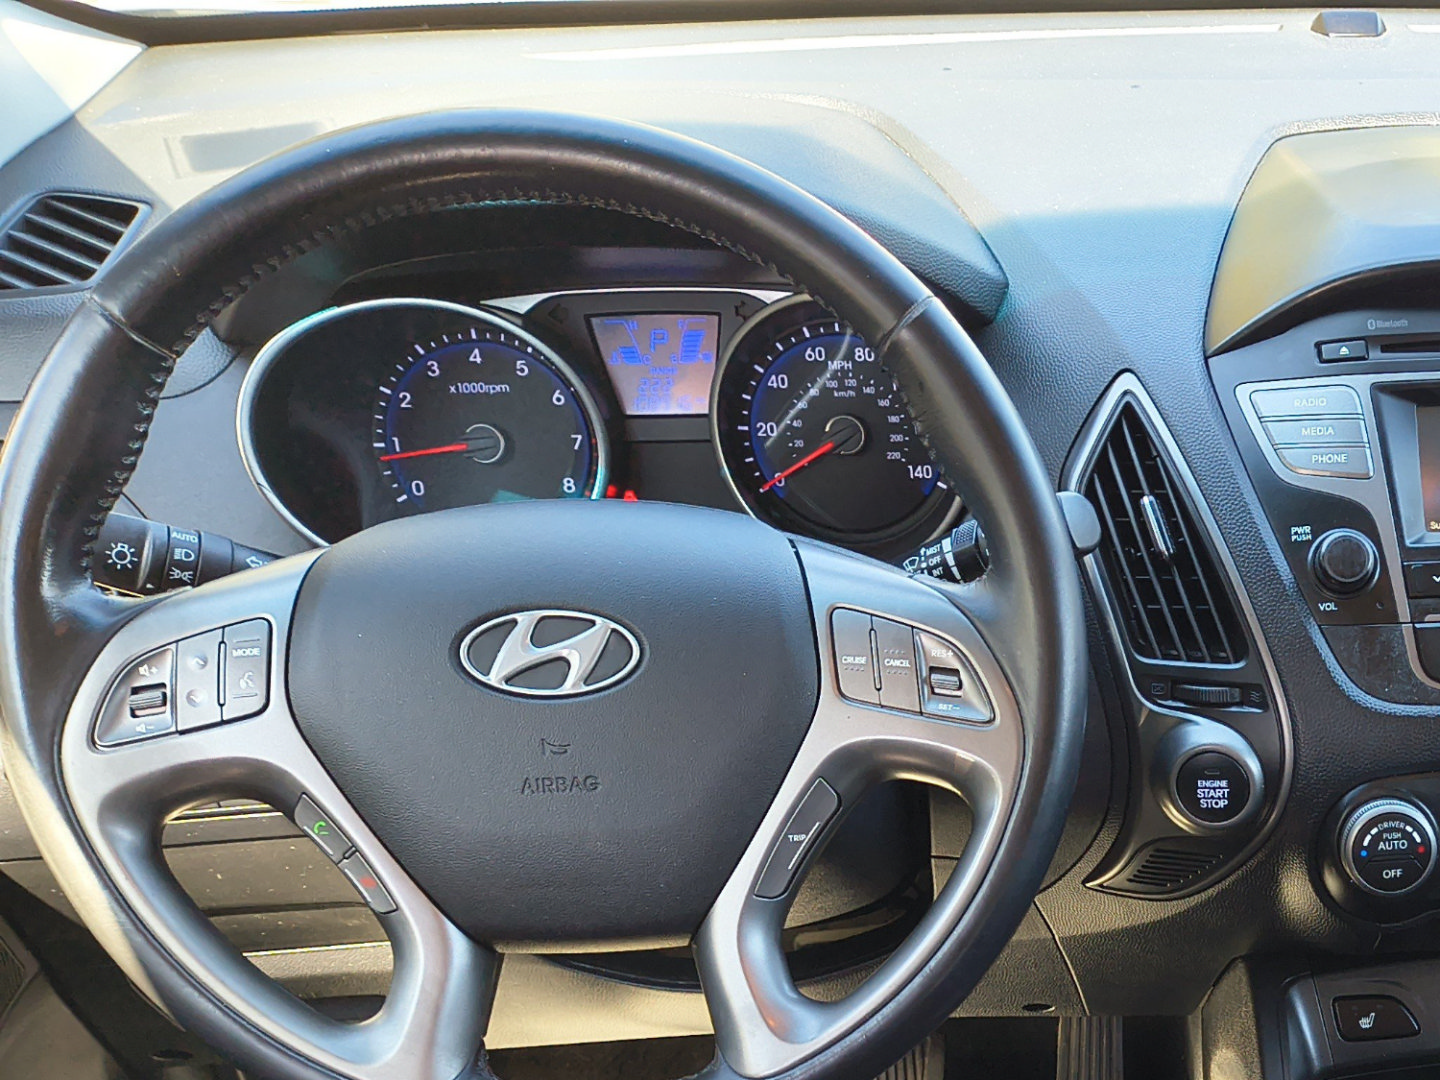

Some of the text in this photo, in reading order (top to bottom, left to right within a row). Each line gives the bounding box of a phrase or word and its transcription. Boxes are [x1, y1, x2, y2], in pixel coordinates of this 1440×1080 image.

[650, 328, 669, 353] P
[469, 348, 482, 364] 4
[805, 347, 825, 361] 60
[855, 347, 875, 361] 80
[427, 361, 440, 377] 3
[515, 361, 529, 377] 5
[827, 361, 852, 371] MPH
[767, 374, 788, 389] 40
[825, 380, 838, 389] 100
[844, 378, 857, 387] 120
[449, 382, 510, 395] x1000rpm
[833, 389, 856, 398] km/h
[862, 386, 875, 394] 140
[399, 392, 413, 408] 2
[552, 390, 565, 406] 6
[877, 399, 890, 407] 160
[1294, 397, 1327, 407] RADIO
[887, 415, 900, 424] 180
[757, 422, 777, 437] 20
[1301, 427, 1335, 436] MEDIA
[571, 435, 583, 450] 7
[889, 434, 903, 442] 200
[392, 437, 400, 452] 1
[886, 451, 901, 460] 220
[1312, 453, 1348, 463] PHONE
[907, 465, 932, 479] 140
[412, 480, 425, 496] 0
[563, 477, 576, 493] 8
[1290, 525, 1311, 534] PWR
[171, 531, 199, 543] AUTO
[1291, 534, 1312, 542] PUSH
[925, 543, 941, 556] MIST
[928, 555, 942, 567] OFF
[932, 566, 943, 577] INT
[1318, 602, 1338, 611] VOL
[232, 647, 261, 657] MODE
[931, 649, 954, 659] RES+
[842, 656, 867, 666] CRUISE
[884, 658, 911, 668] CANCEL
[521, 774, 600, 796] AIRBAG
[1197, 779, 1228, 788] ENGINE
[1196, 788, 1230, 798] START
[1200, 799, 1228, 808] STOP
[1378, 820, 1406, 830] DRIVER
[1383, 832, 1401, 840] PUSH
[1377, 840, 1408, 851] AUTO
[1383, 869, 1403, 879] OFF
